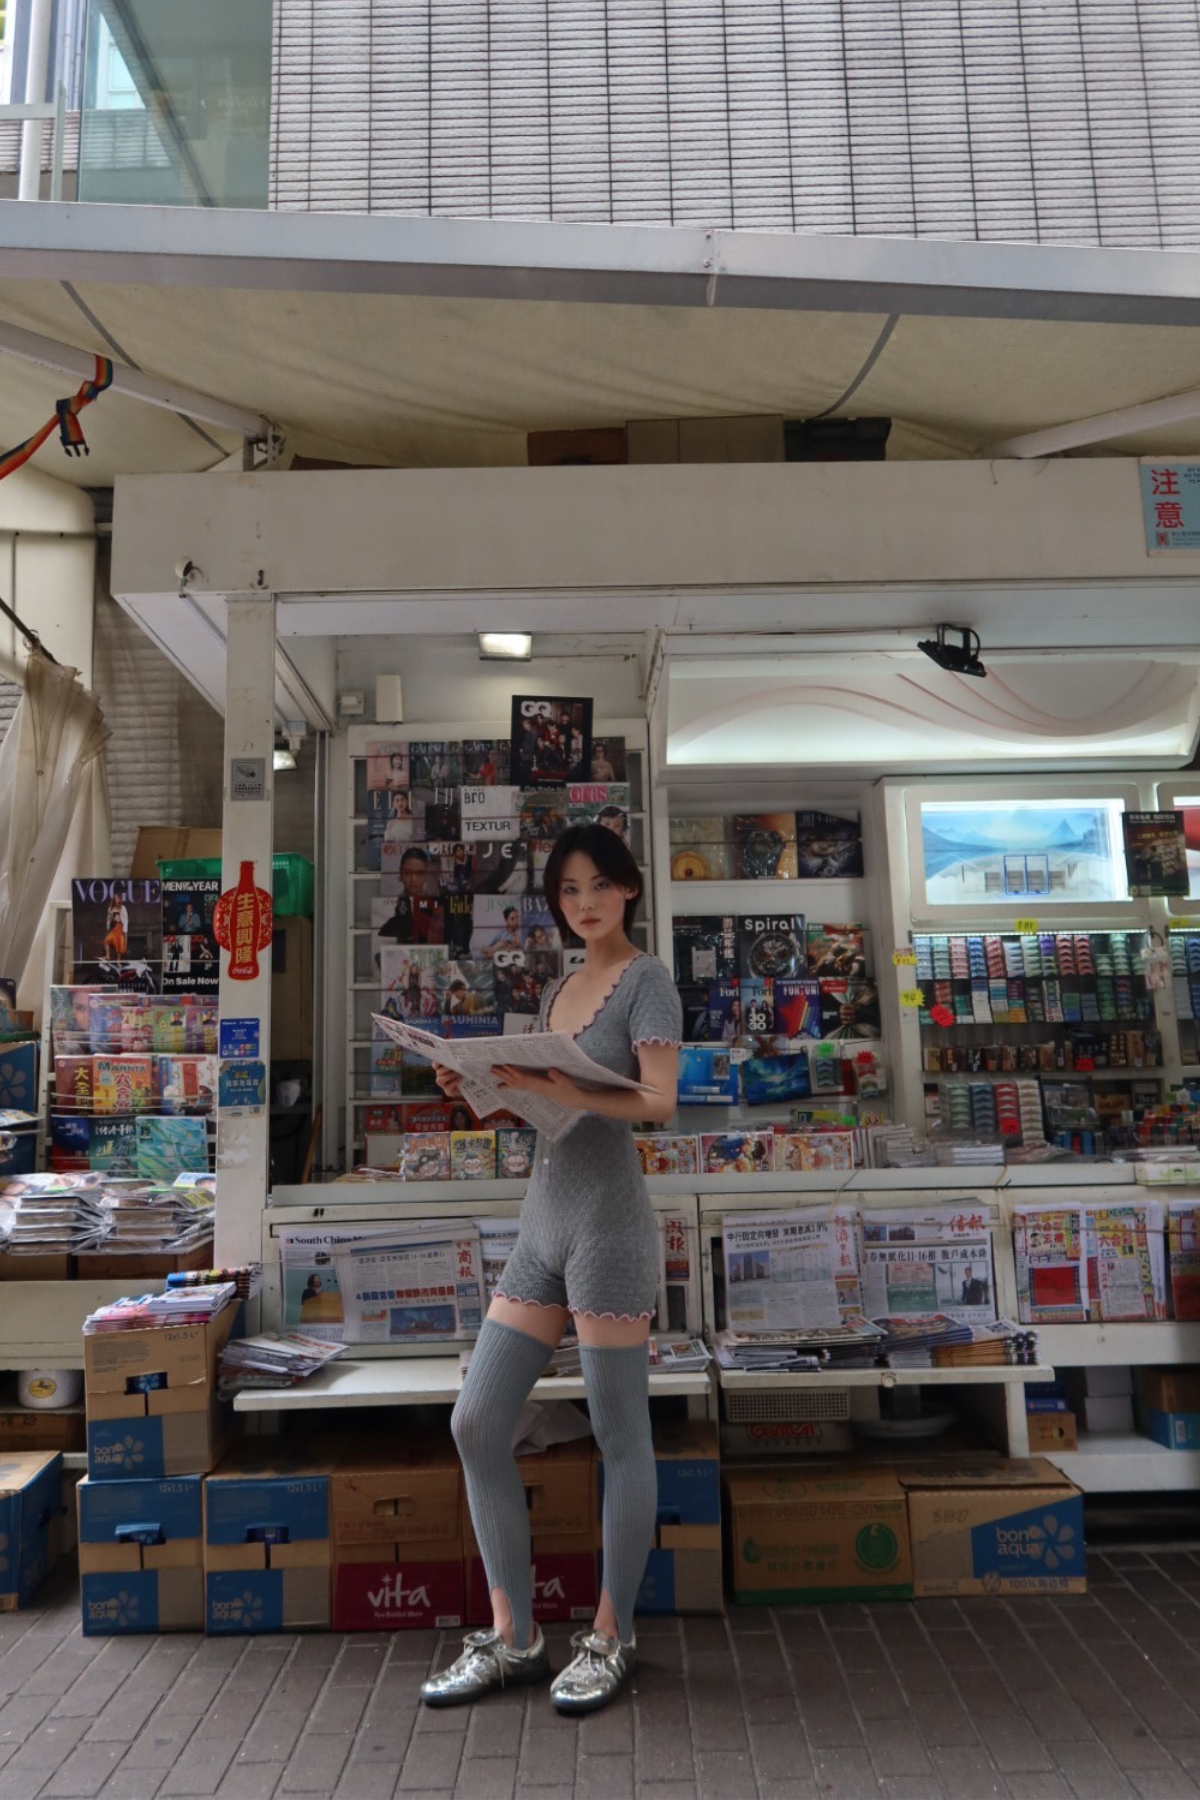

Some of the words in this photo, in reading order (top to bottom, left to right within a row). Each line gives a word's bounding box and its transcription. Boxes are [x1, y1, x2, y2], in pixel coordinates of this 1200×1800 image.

[1151, 468, 1184, 528] 注意
[521, 700, 552, 718] GQ
[75, 880, 160, 904] VOGUE
[193, 881, 218, 891] YEAR
[236, 892, 255, 964] 生意興隆
[744, 916, 795, 933] Spiral
[494, 949, 525, 967] GQ
[176, 976, 196, 985] Sale
[197, 976, 219, 985] Now
[441, 1015, 498, 1025] BAUHINIA
[748, 1013, 767, 1022] 30
[748, 1022, 767, 1031] 30
[949, 1213, 986, 1233] 信報
[294, 1235, 322, 1245] South
[996, 1526, 1029, 1542] bon
[997, 1543, 1039, 1558] aqua
[367, 1572, 431, 1607] vita
